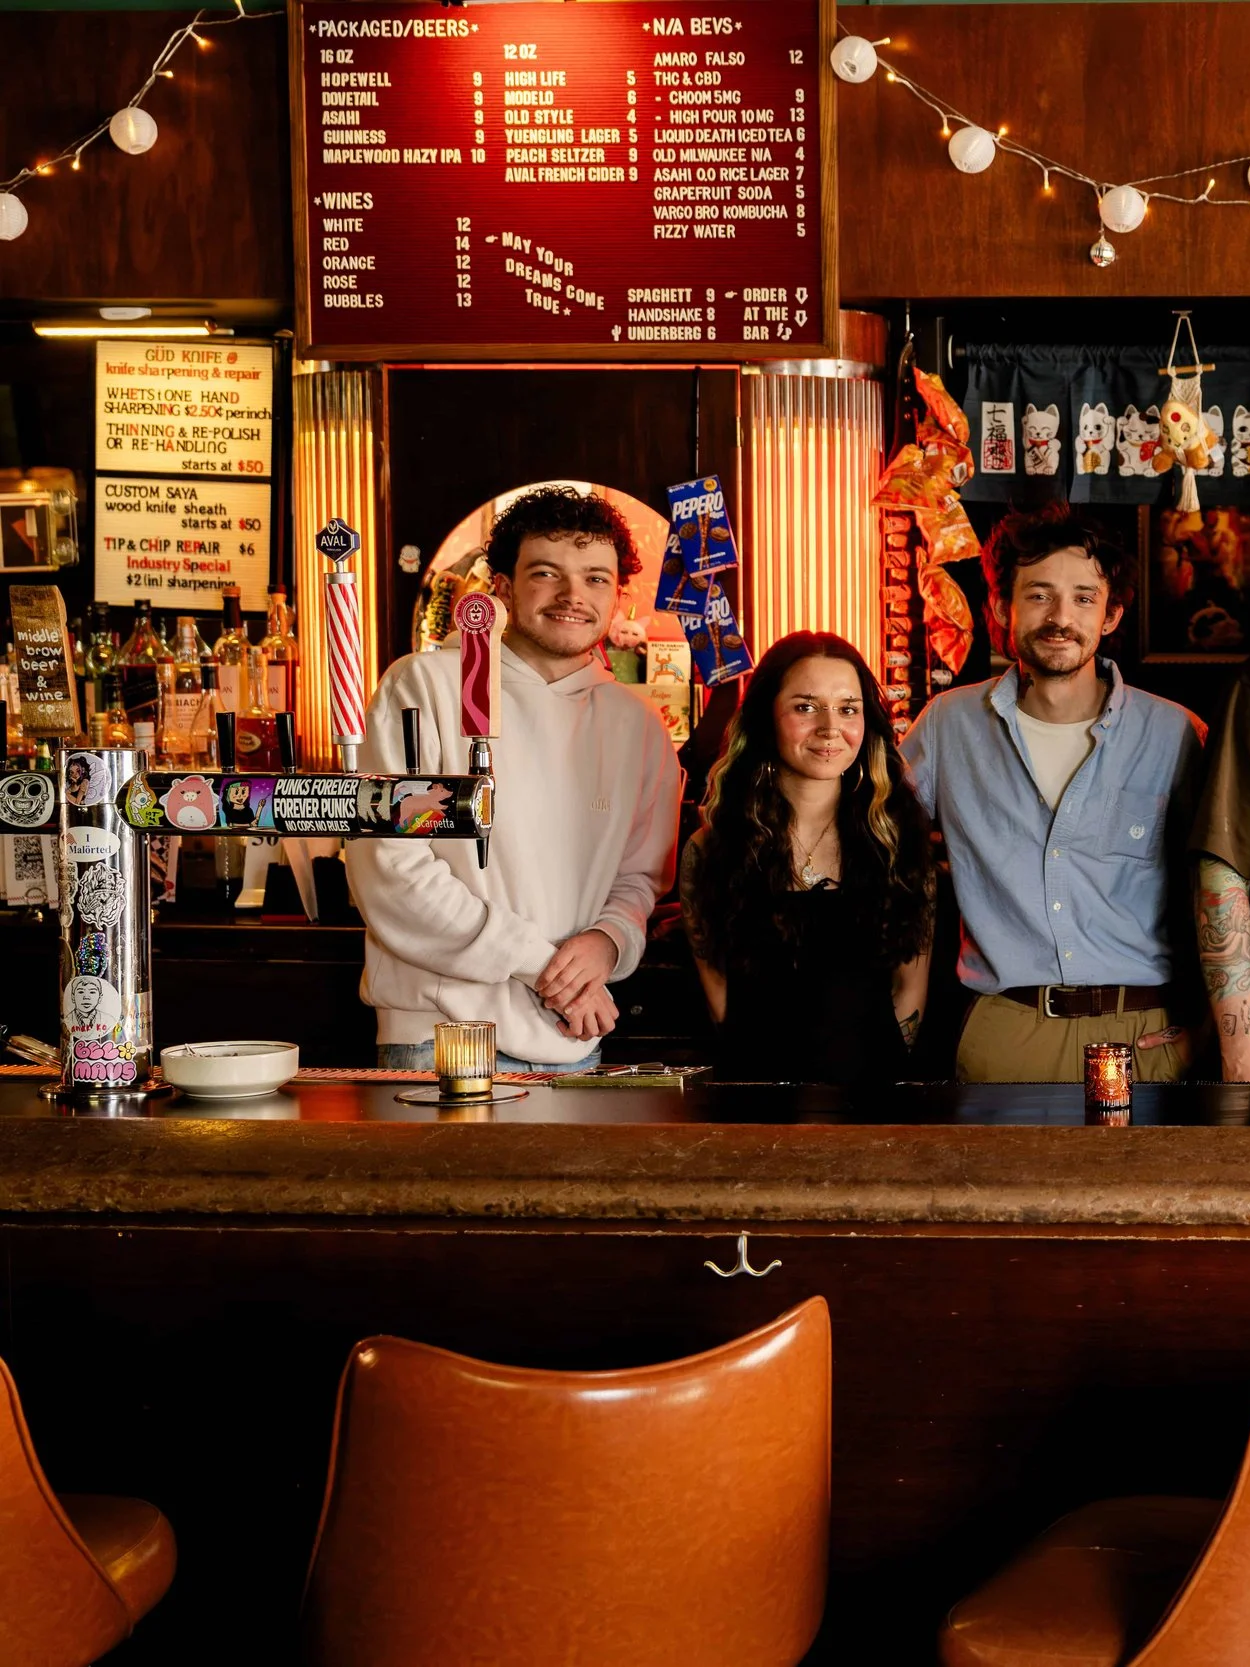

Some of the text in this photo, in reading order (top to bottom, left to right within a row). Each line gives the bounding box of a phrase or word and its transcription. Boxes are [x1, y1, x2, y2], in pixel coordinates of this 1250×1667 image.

[319, 19, 469, 37] PACKAGED/BEERS
[653, 17, 733, 36] N/A BEVS
[654, 51, 745, 67] AMARO FALSO
[321, 72, 391, 87] HOPEWELL
[505, 71, 566, 86] HIGH LIFE
[322, 92, 379, 106] DOVETAIL
[504, 90, 554, 106] MODELO
[322, 111, 360, 125] ASAHI
[504, 109, 573, 124] OLD STYLE
[324, 130, 386, 144] GUINNESS
[505, 128, 620, 144] YUENGLING LAGER
[323, 149, 462, 163] MAPLEWOOD HAZY IPA
[506, 148, 605, 163] PEACH SELTZER
[323, 192, 373, 209] WINES
[654, 186, 772, 200] GRAPEFRUIT SODA
[723, 205, 788, 219] KOMBUCHA
[323, 218, 363, 232] WHITE
[654, 224, 735, 239] FIZZY WATER
[324, 237, 349, 251] RED
[502, 232, 573, 276] MAY YOUR
[323, 256, 375, 270] ORANGE
[323, 275, 357, 289] ROSE
[506, 258, 604, 310] DREAMS COME
[324, 294, 383, 308] BUBBLES
[525, 289, 559, 314] TRUE
[628, 288, 692, 302] SPAGHETT
[743, 288, 787, 302] ORDER
[629, 308, 702, 322] HANDSHAKE
[744, 307, 788, 321] AT THE
[628, 326, 701, 340] UNDERBERG
[743, 326, 769, 340] BAR
[145, 346, 175, 362] GÜD
[106, 362, 135, 375] knife
[224, 367, 262, 382] repair
[106, 423, 260, 441] THINNING & RE-POLISH
[105, 484, 198, 500] CUSTOM SAYA
[105, 500, 227, 516] wood knife sheath
[672, 491, 724, 522] PEPERO
[181, 518, 261, 531] starts at $50
[139, 537, 255, 556] CHIP REPAIR $6
[320, 535, 347, 547] AVAL
[127, 555, 231, 574] Industry Special
[17, 629, 60, 643] middle
[26, 643, 62, 657] brow
[21, 657, 59, 672] beer
[36, 675, 48, 689] &
[26, 690, 64, 702] wine
[274, 779, 359, 796] PUNKS FOREVER
[274, 798, 356, 819] FOREVER PUNKS
[285, 821, 351, 832] NO COPS NO RULES
[415, 817, 454, 833] Scarpetta
[69, 844, 111, 854] Malörted
